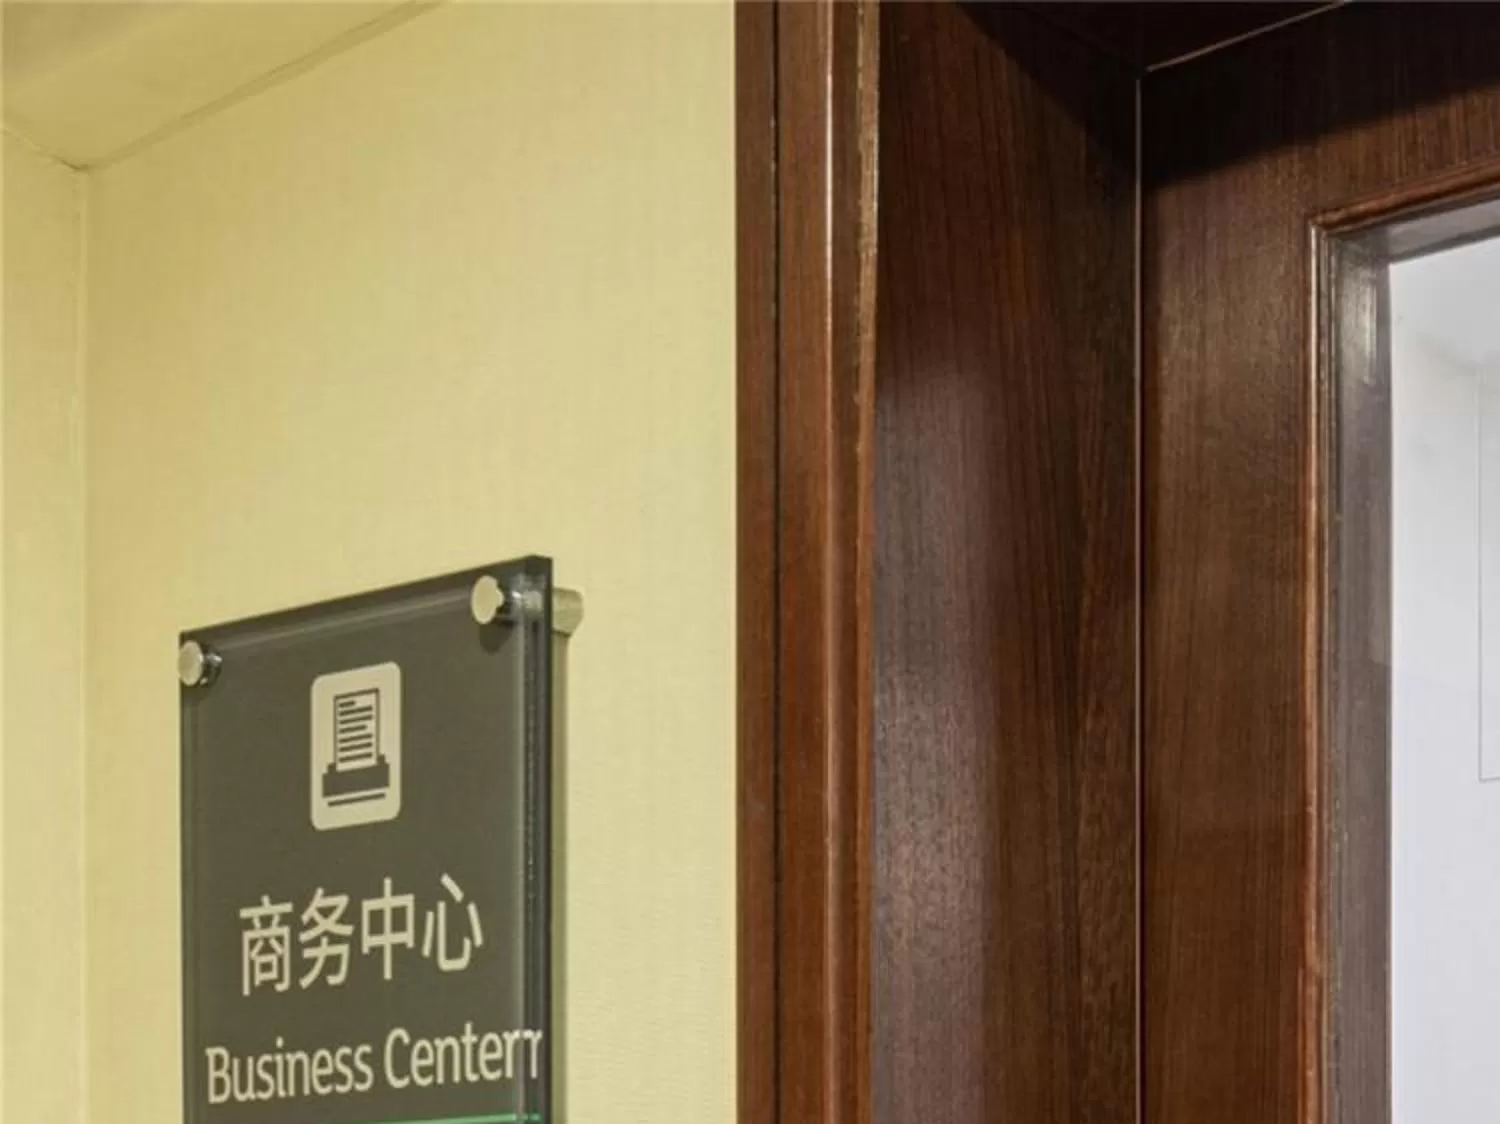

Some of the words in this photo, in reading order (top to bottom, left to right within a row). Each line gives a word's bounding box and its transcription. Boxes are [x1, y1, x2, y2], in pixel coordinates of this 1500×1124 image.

[239, 873, 484, 996] 商务中心
[205, 1036, 373, 1104] Business
